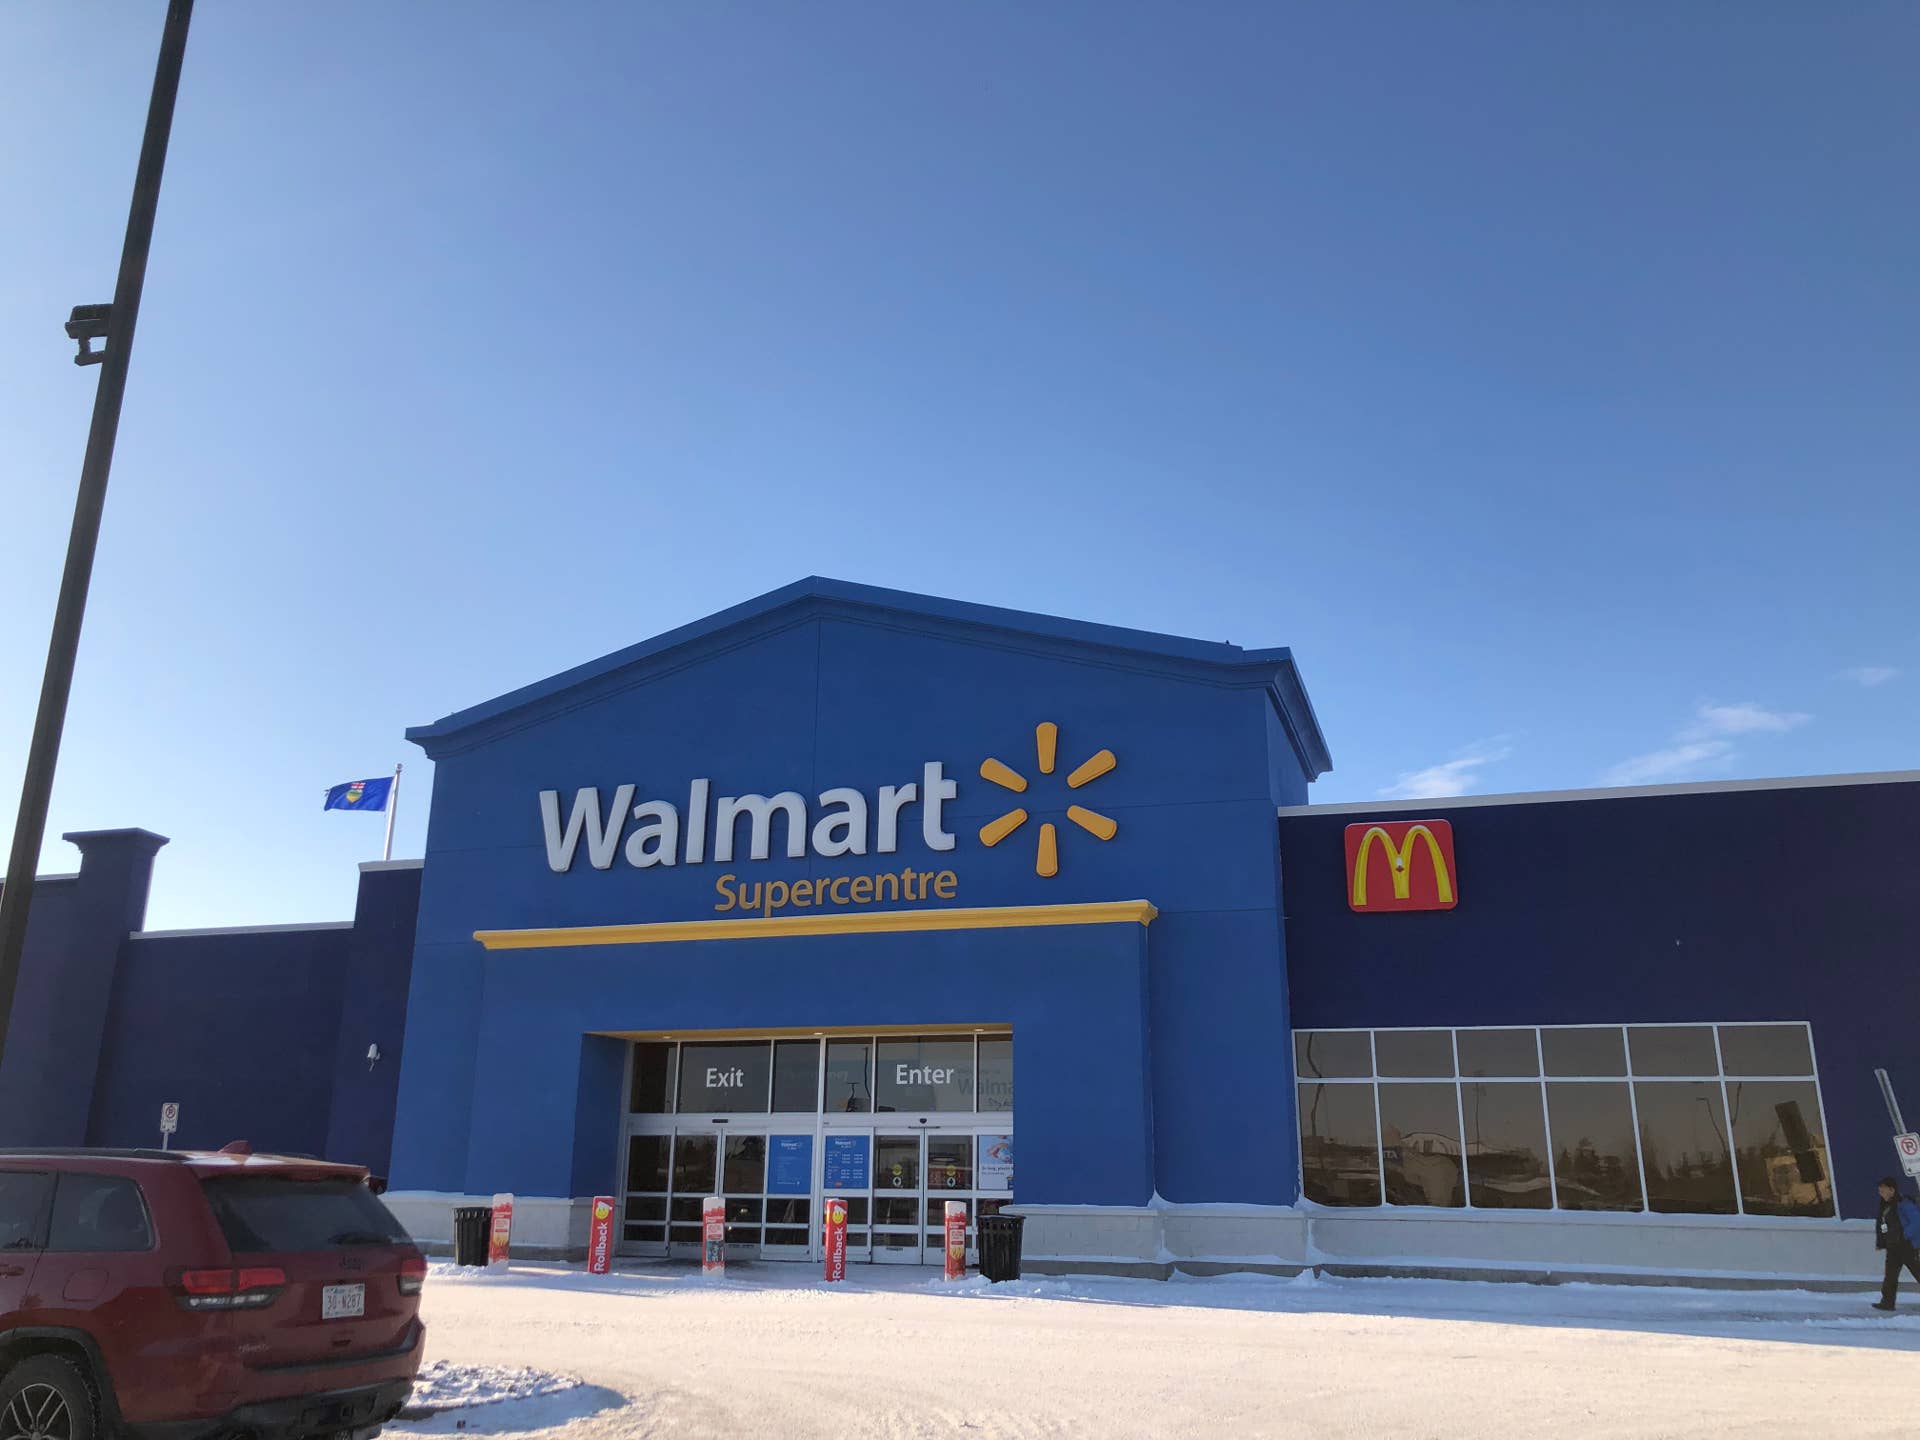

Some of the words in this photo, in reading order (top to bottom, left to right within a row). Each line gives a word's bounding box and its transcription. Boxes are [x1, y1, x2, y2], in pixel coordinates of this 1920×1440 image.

[539, 761, 957, 873] Walmart
[714, 868, 957, 918] Supercentre
[706, 1067, 744, 1088] Exit
[896, 1063, 954, 1086] Enter
[593, 1221, 608, 1272] Rollback
[832, 1226, 843, 1279] Rollback
